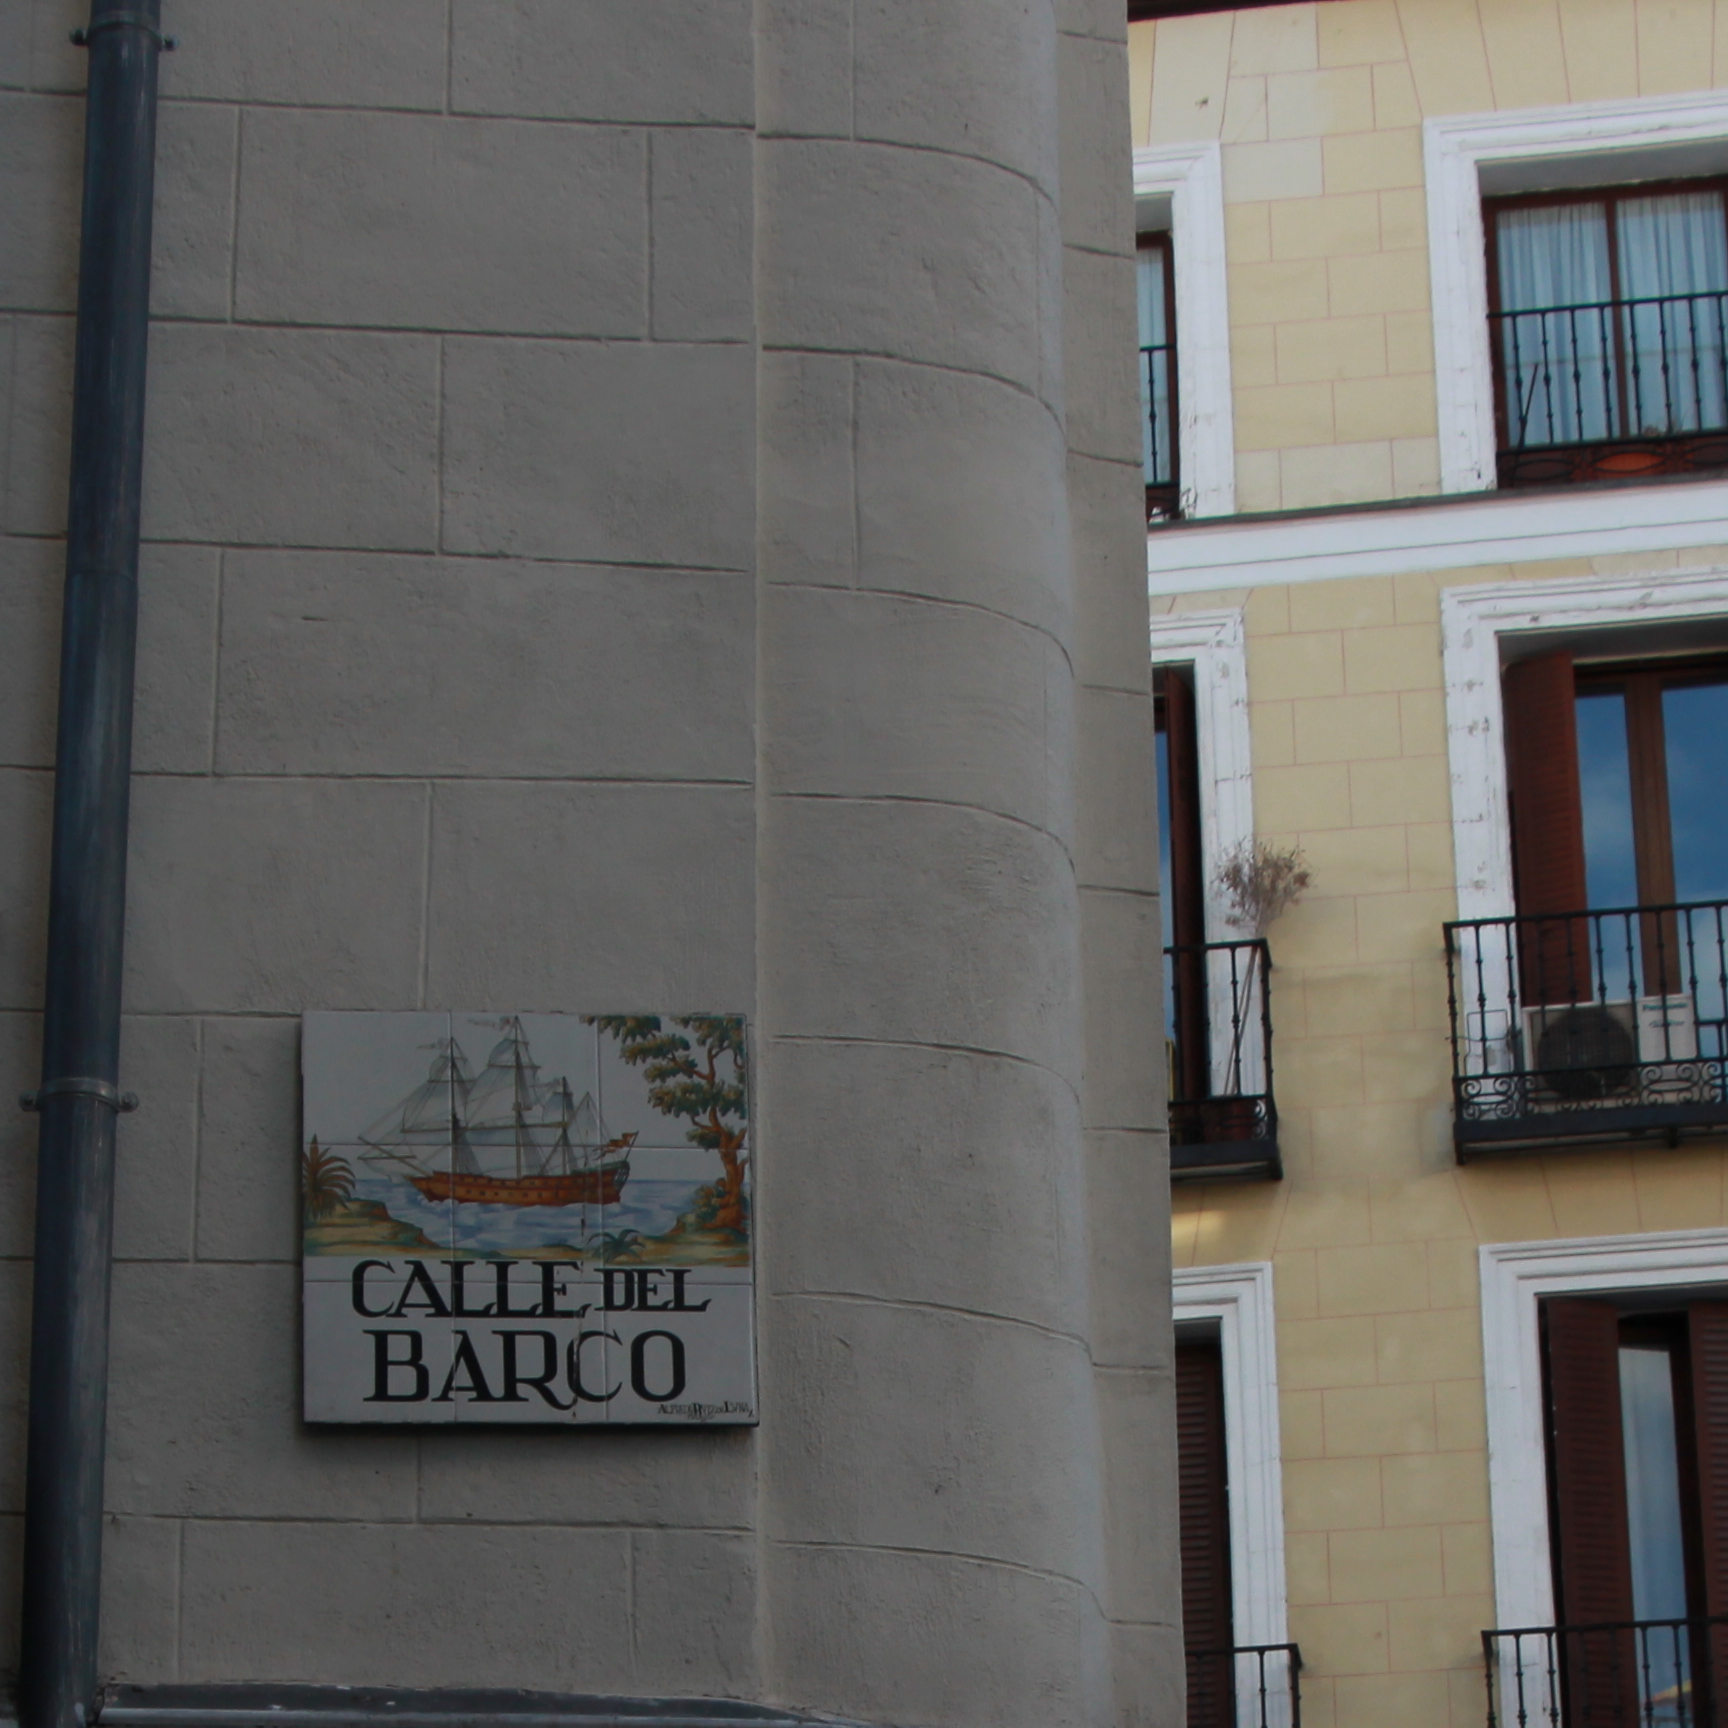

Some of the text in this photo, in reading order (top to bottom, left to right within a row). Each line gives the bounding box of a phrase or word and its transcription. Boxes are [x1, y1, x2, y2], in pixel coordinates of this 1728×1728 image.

[351, 1260, 712, 1319] CALLE DEL
[362, 1329, 687, 1411] BARCO
